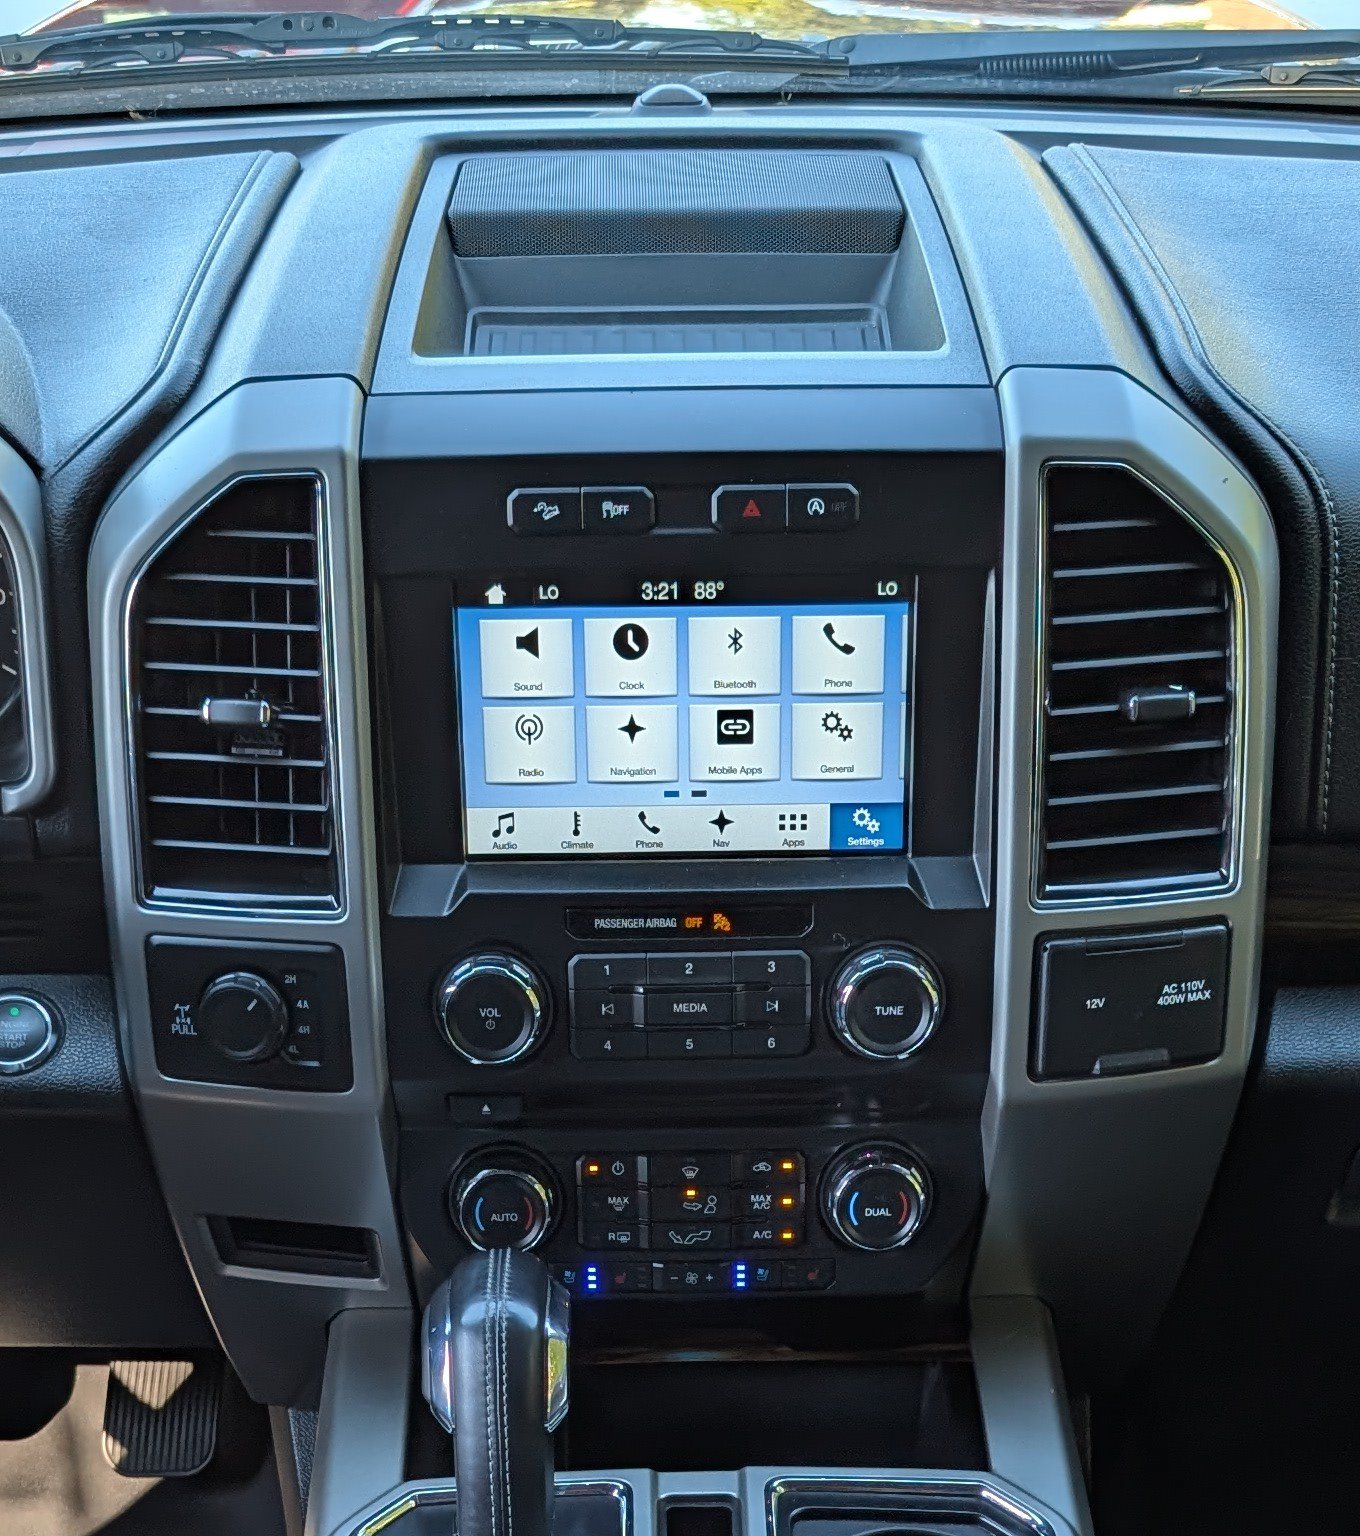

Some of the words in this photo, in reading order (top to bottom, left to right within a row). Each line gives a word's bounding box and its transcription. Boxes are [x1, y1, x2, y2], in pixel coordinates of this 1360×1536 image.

[612, 503, 629, 516] OFF
[539, 585, 559, 600] LO
[641, 582, 679, 600] 3:21
[693, 581, 725, 600] 88°
[877, 581, 898, 596] LO
[513, 681, 544, 692] Sound
[618, 680, 646, 691] Clock
[713, 678, 758, 689] Bluetooth
[824, 677, 853, 688] Phone
[517, 766, 545, 777] Radio
[609, 765, 657, 778] Navigation
[707, 764, 738, 776] Mobile
[738, 764, 763, 778] Apps
[820, 763, 855, 774] General
[492, 840, 518, 851] Audio
[560, 839, 594, 850] Climate
[635, 839, 664, 850] Phone
[712, 838, 731, 848] Nav
[781, 837, 806, 850] Apps
[846, 836, 886, 848] Settings
[594, 917, 645, 929] PASSENGER
[645, 917, 678, 928] AIRBAG
[684, 917, 703, 928] OFF
[603, 963, 611, 976] 1
[684, 962, 694, 974] 2
[766, 961, 776, 973] 3
[284, 974, 297, 984] 2H
[1161, 982, 1178, 995] AC
[1180, 978, 1206, 993] 110V
[1156, 994, 1187, 1006] 400W
[1187, 988, 1212, 1002] MAX
[296, 999, 310, 1009] 4A
[672, 1002, 708, 1014] MEDIA
[1085, 997, 1106, 1010] 12V
[478, 1007, 502, 1019] VOL
[874, 1005, 905, 1017] TUNE
[171, 1023, 198, 1036] PULL
[603, 1039, 612, 1051] 4
[685, 1038, 694, 1050] 5
[767, 1037, 776, 1049] 6
[607, 1196, 630, 1205] MAX
[750, 1194, 772, 1203] MAX
[753, 1202, 771, 1210] A/C
[864, 1206, 892, 1217] DUAL
[490, 1211, 519, 1223] AUTO
[608, 1232, 616, 1241] R
[753, 1230, 772, 1239] A/C
